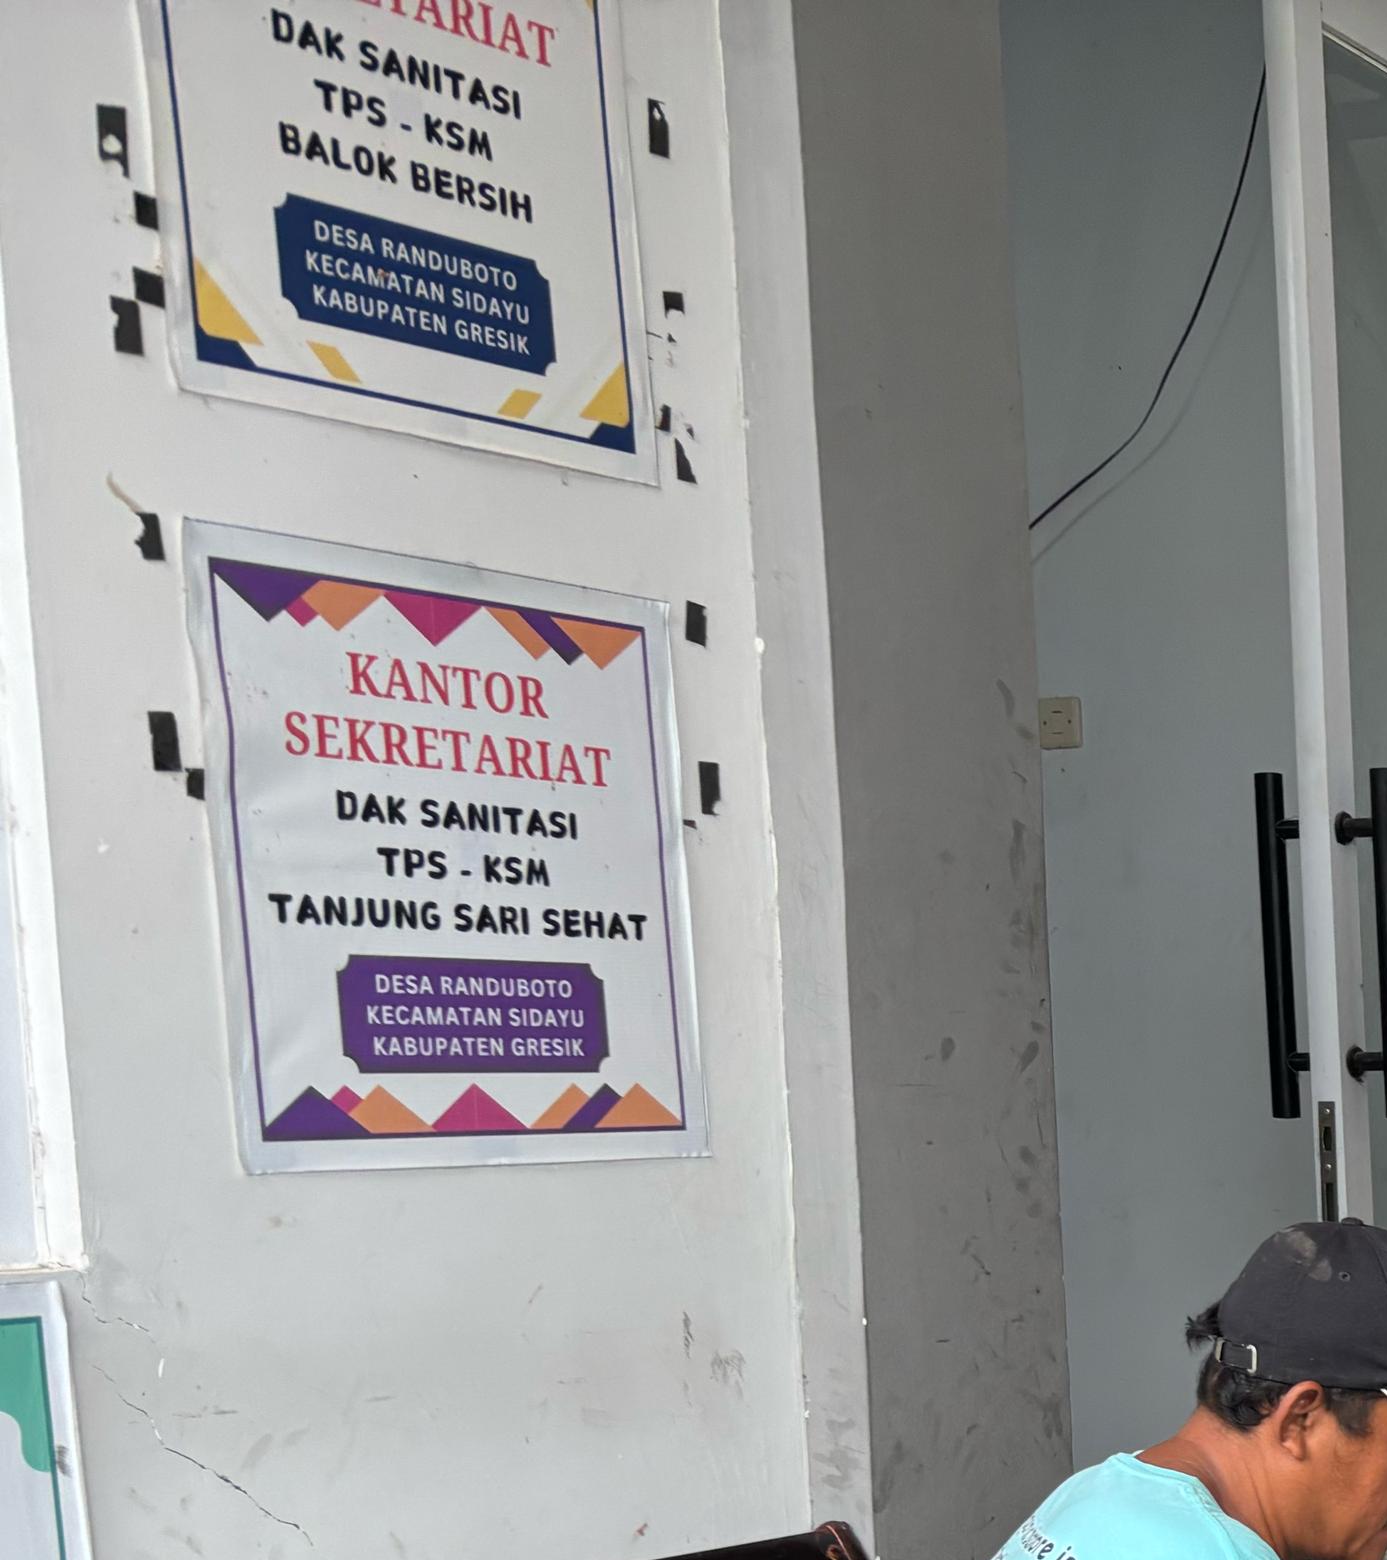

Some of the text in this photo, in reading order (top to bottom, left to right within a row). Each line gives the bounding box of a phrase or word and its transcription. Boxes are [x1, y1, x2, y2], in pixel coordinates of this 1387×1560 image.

[270, 7, 522, 121] DAK SANITASI
[356, 0, 556, 68] ARIAT
[312, 77, 494, 163] TPS - KSM
[278, 120, 534, 224] BALOK BERSIH
[305, 249, 530, 325] KECAMATAN SIDAYU
[313, 219, 518, 292] DESA RANDUBOTO
[312, 284, 530, 356] KABUPATEN GRESIK
[345, 650, 550, 720] KANTOR
[283, 710, 612, 788] SEKRETARIAT
[335, 788, 578, 841] DAK SANITASI
[376, 846, 448, 880] TPS
[483, 853, 551, 888] KSM
[267, 892, 648, 942] TANJUNG SARI SEHAT
[366, 1004, 585, 1028] KECAMATAN SIDAYU
[374, 973, 573, 999] DESA RANDUBOTO
[373, 1035, 585, 1057] KABUPATEN GRESIK
